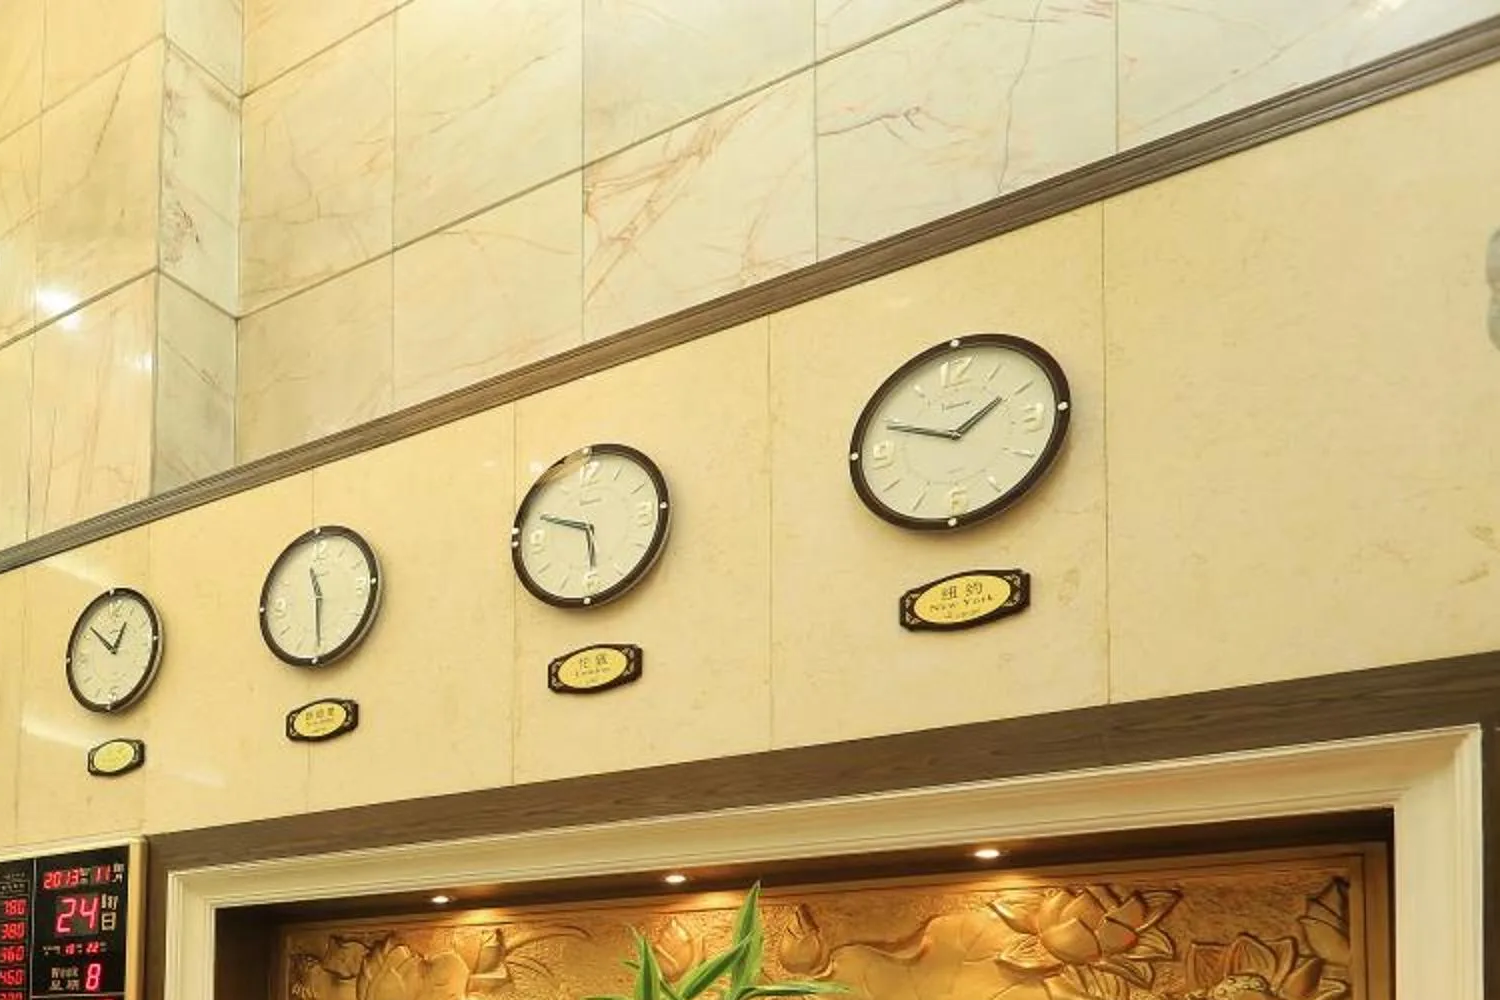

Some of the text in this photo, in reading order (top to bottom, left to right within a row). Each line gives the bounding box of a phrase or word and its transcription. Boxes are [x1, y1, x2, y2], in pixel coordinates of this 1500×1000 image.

[43, 868, 80, 889] 2013
[55, 897, 100, 934] 24
[86, 963, 101, 991] 8
